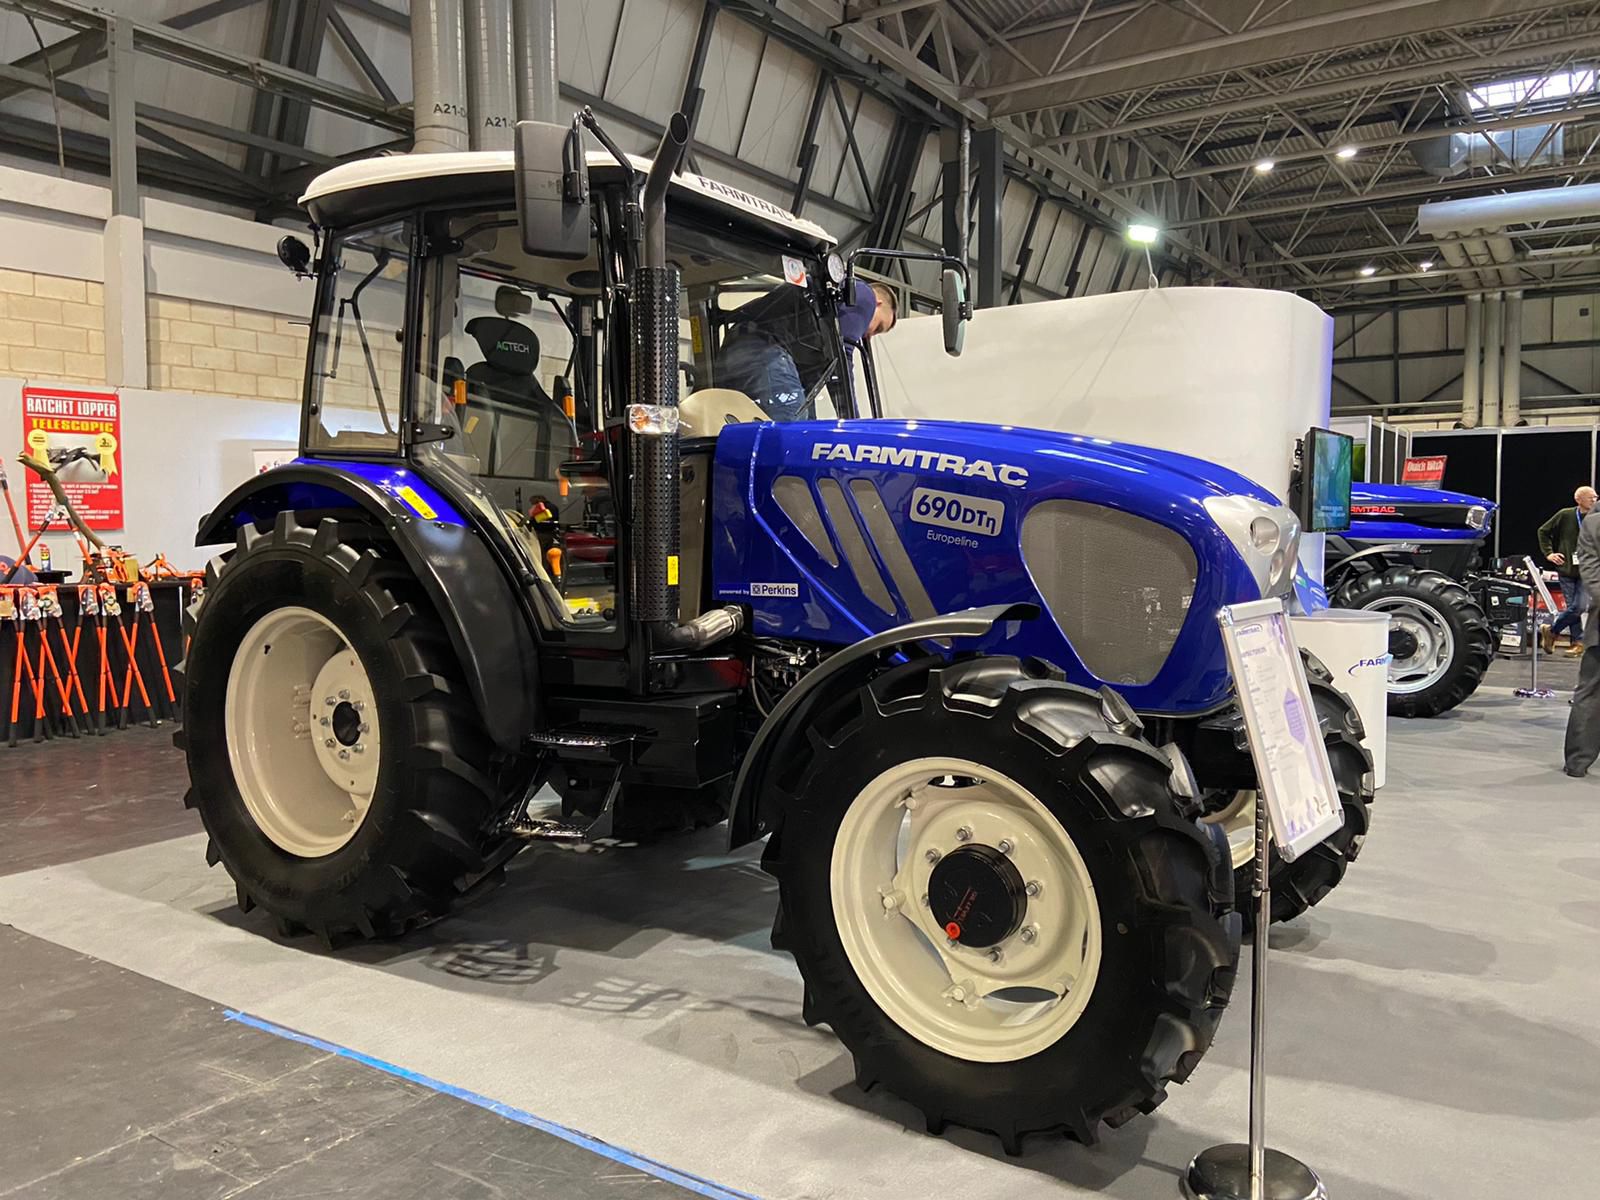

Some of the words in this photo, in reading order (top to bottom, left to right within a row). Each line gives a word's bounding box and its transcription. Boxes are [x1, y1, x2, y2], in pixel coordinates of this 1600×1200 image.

[496, 341, 530, 353] AGTECH
[26, 397, 74, 415] RATCHET
[77, 401, 117, 417] LOPPER
[32, 418, 114, 433] TELESCOPIC
[811, 442, 1029, 487] FARMTRAC
[926, 529, 979, 549] Europeline
[761, 584, 797, 596] Perkins
